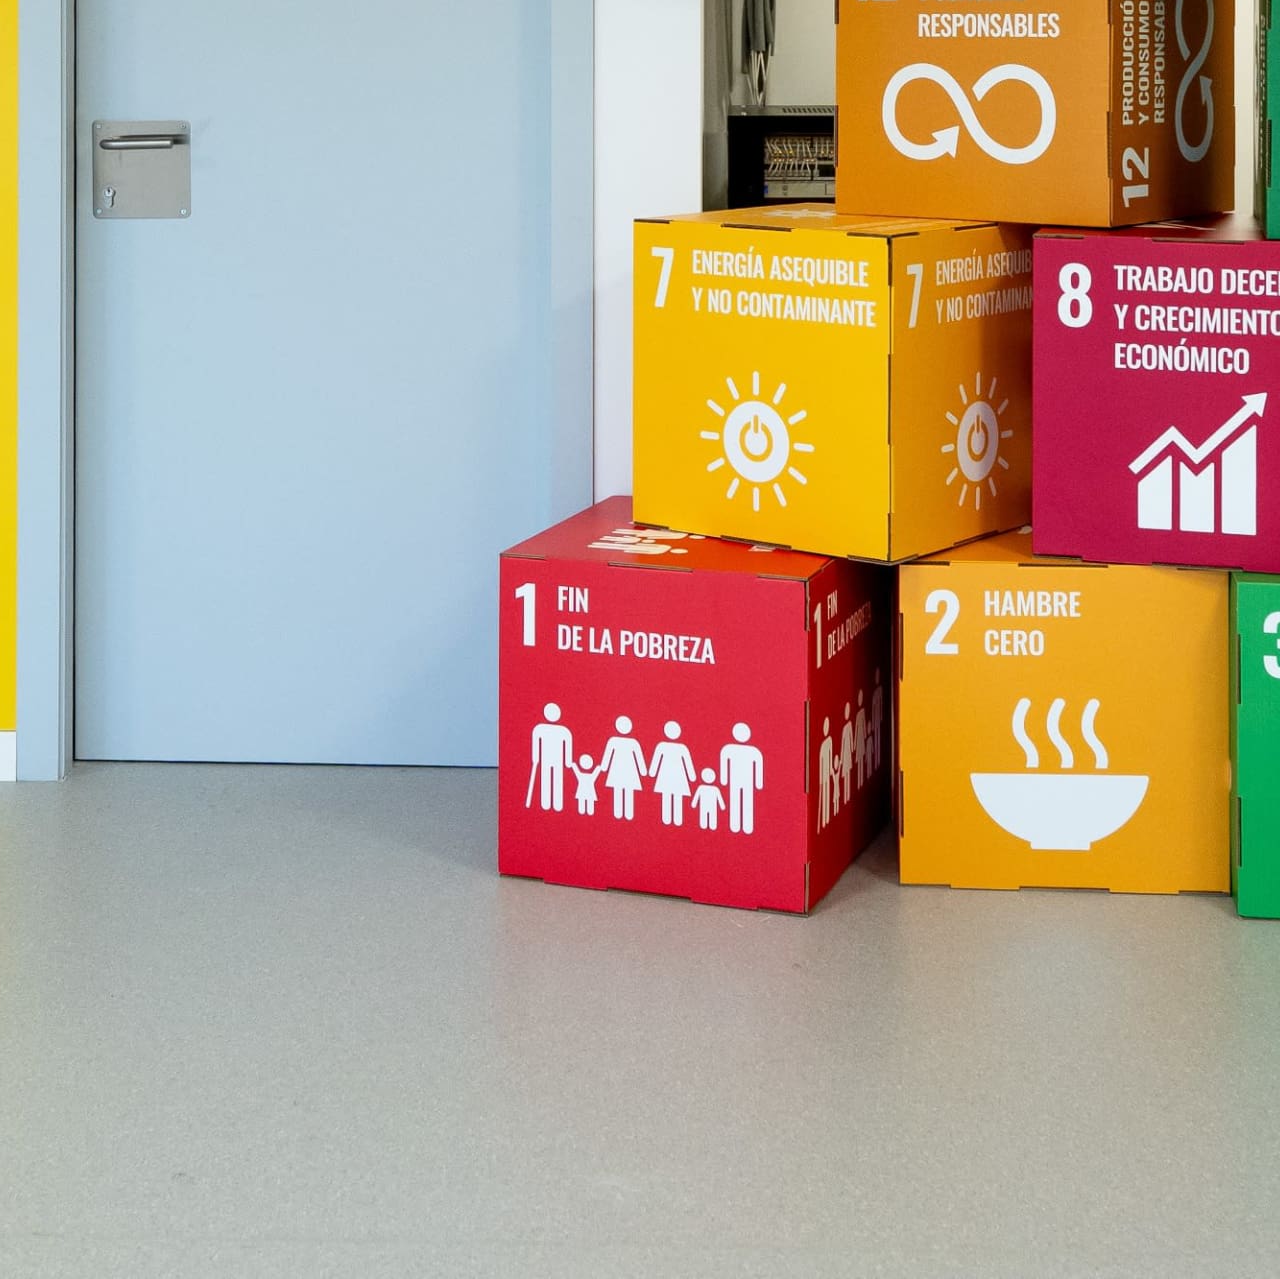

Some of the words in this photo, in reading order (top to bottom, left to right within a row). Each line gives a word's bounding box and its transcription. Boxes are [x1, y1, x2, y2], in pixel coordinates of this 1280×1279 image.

[918, 13, 1060, 38] RESPONSABLES
[1139, 1, 1149, 105] CONSUMO
[1139, 112, 1149, 125] Y
[1122, 147, 1149, 207] 12
[651, 247, 674, 307] 7
[692, 246, 765, 279] ENERGÍA
[769, 256, 869, 288] ASEQUIBLE
[907, 264, 923, 328] 7
[936, 249, 983, 286] ENERGÍA
[987, 249, 1032, 278] ASEQUIB
[1058, 263, 1092, 328] 8
[1114, 265, 1213, 293] TRABAJO
[692, 287, 703, 311] Y
[708, 288, 732, 314] NO
[736, 291, 876, 328] CONTAMINANTE
[936, 299, 943, 324] Y
[947, 297, 963, 322] NO
[967, 286, 1033, 319] CONTAMINA
[1114, 304, 1128, 329] Y
[1115, 338, 1249, 374] ECONÓMICO
[516, 583, 535, 646] 1
[558, 586, 588, 613] FIN
[813, 602, 822, 670] 1
[827, 589, 838, 620] FIN
[925, 589, 960, 655] 2
[984, 590, 1080, 617] HAMBRE
[558, 624, 583, 651] DE
[589, 627, 613, 654] LA
[620, 630, 715, 664] POBREZA
[827, 630, 837, 660] DE
[837, 623, 846, 652] LA
[984, 629, 1044, 656] CERO
